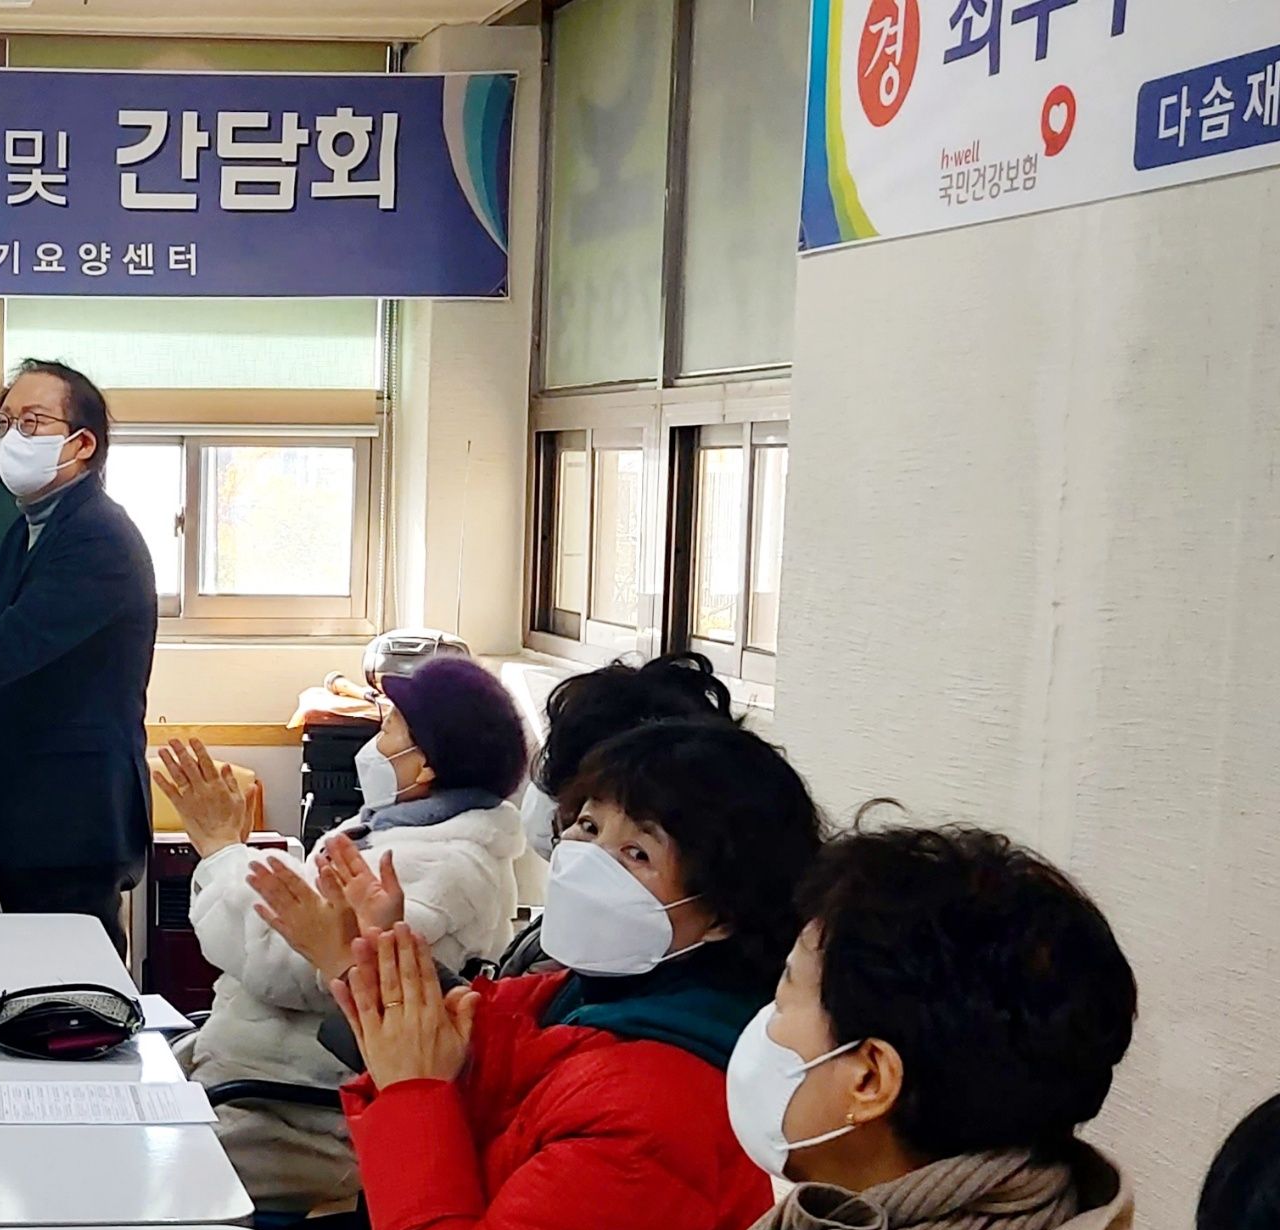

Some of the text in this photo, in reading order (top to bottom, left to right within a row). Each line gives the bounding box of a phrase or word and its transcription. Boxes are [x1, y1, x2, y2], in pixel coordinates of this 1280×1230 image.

[864, 0, 904, 106] 경
[1158, 60, 1280, 147] 다솜재
[5, 129, 68, 206] 및
[116, 107, 400, 210] 간담회
[939, 153, 1038, 206] 국민건강보험
